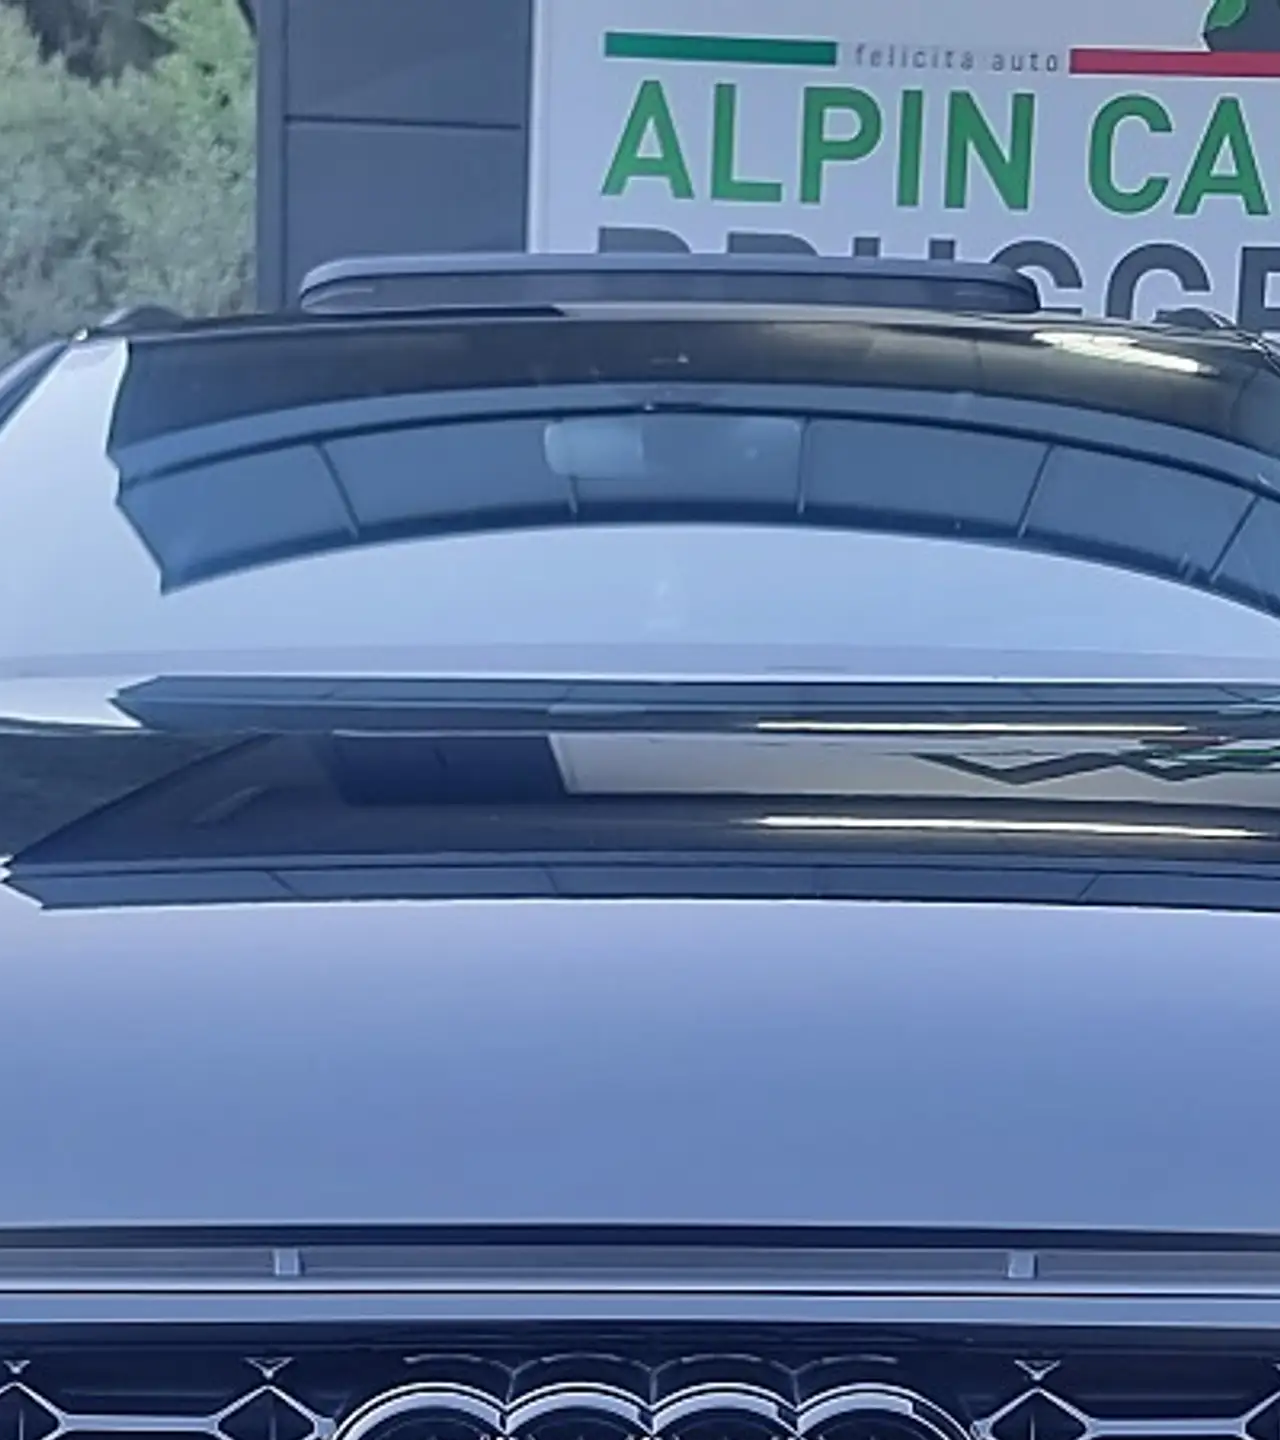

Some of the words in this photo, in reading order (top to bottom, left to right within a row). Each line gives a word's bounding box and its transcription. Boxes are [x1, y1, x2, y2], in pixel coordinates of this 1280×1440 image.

[854, 43, 974, 70] felicita
[991, 53, 1058, 72] auto
[601, 79, 1034, 210] ALPIN
